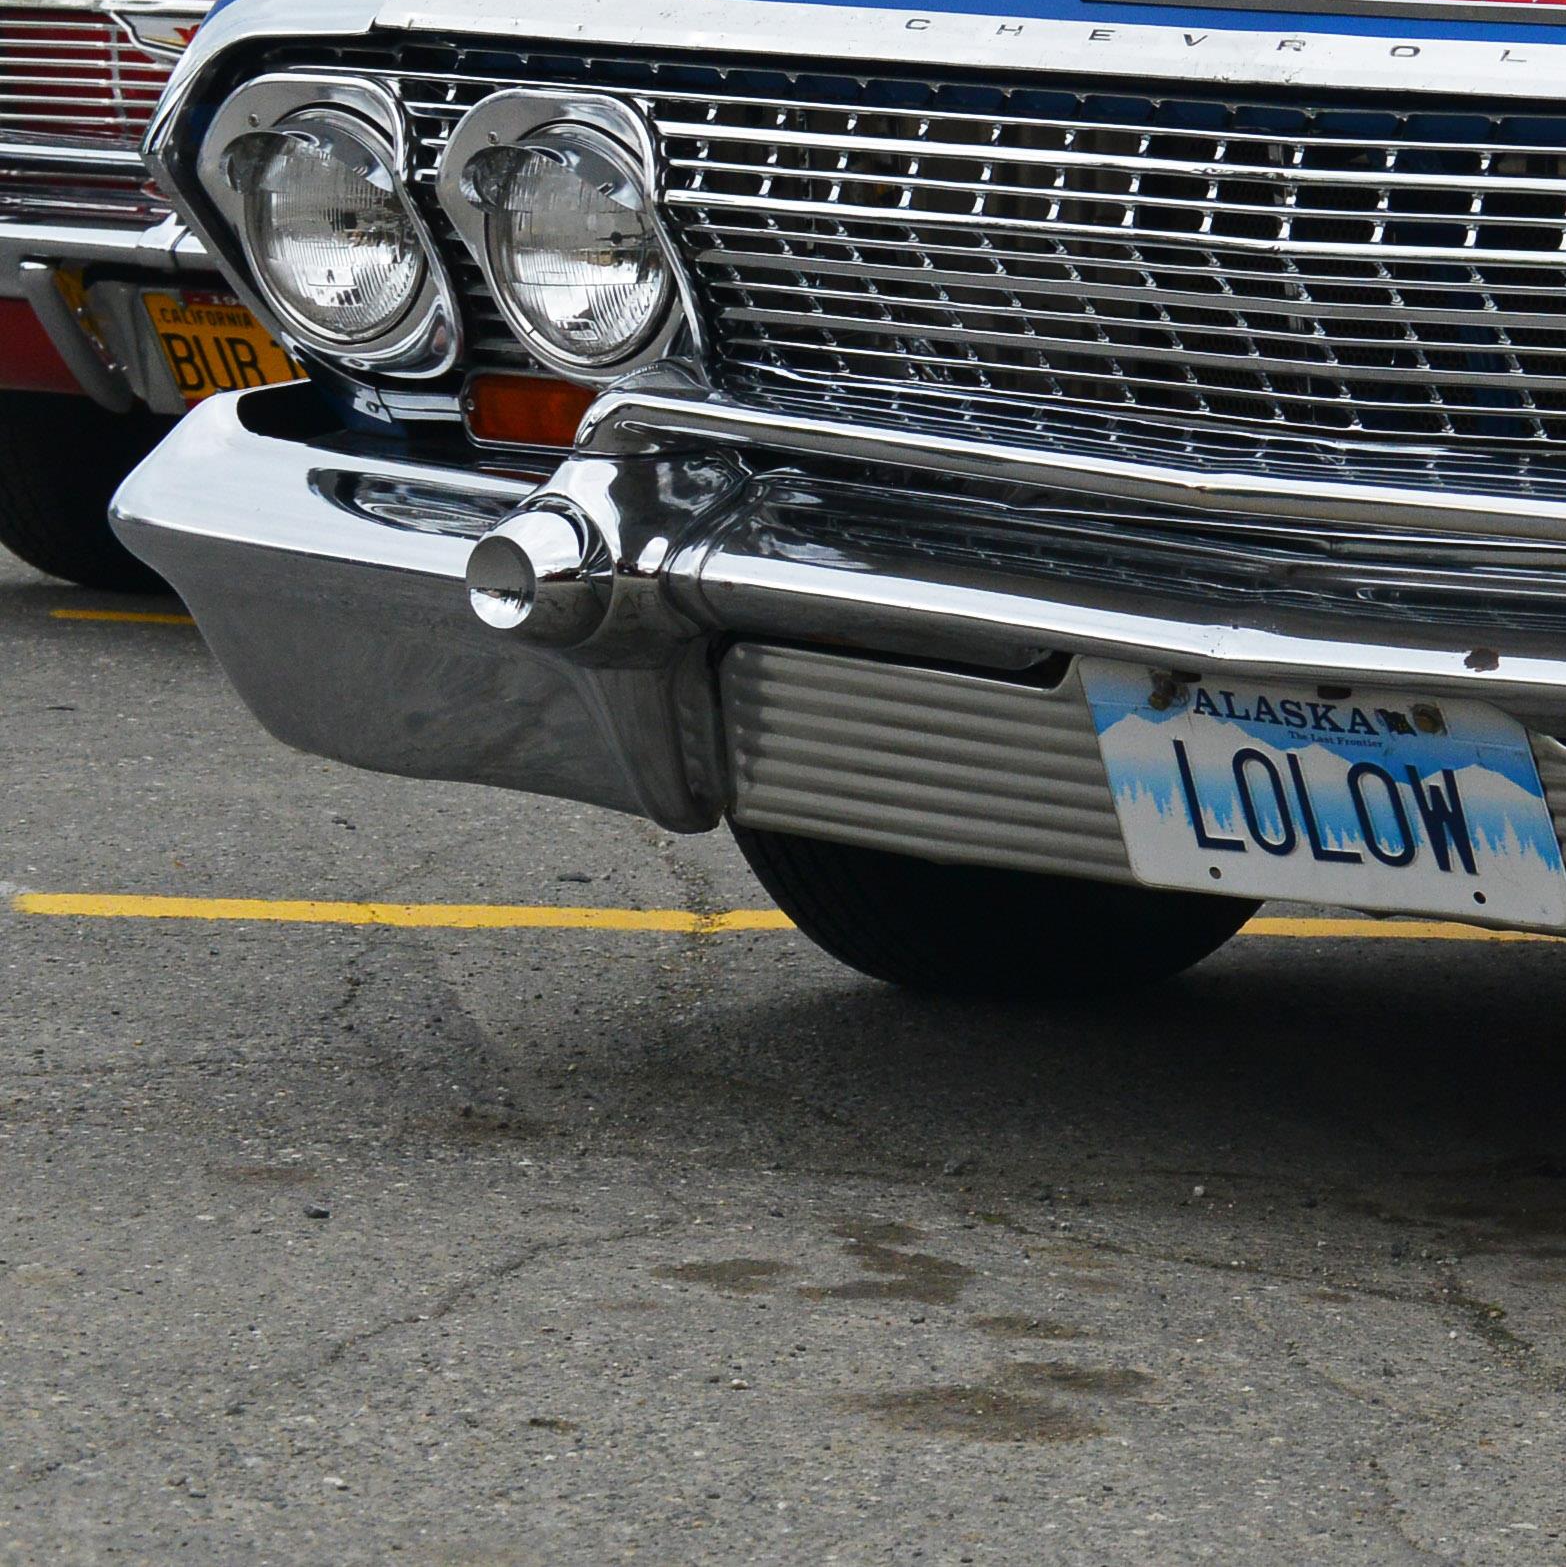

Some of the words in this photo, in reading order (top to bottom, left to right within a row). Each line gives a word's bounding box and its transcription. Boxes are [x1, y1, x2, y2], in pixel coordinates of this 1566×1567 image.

[160, 307, 254, 328] CALIFORNIA
[162, 333, 268, 391] BUR
[1193, 687, 1381, 736] ALASKA
[1310, 734, 1335, 745] Last
[1336, 737, 1383, 749] Frontier
[1173, 739, 1480, 876] LOLOW
